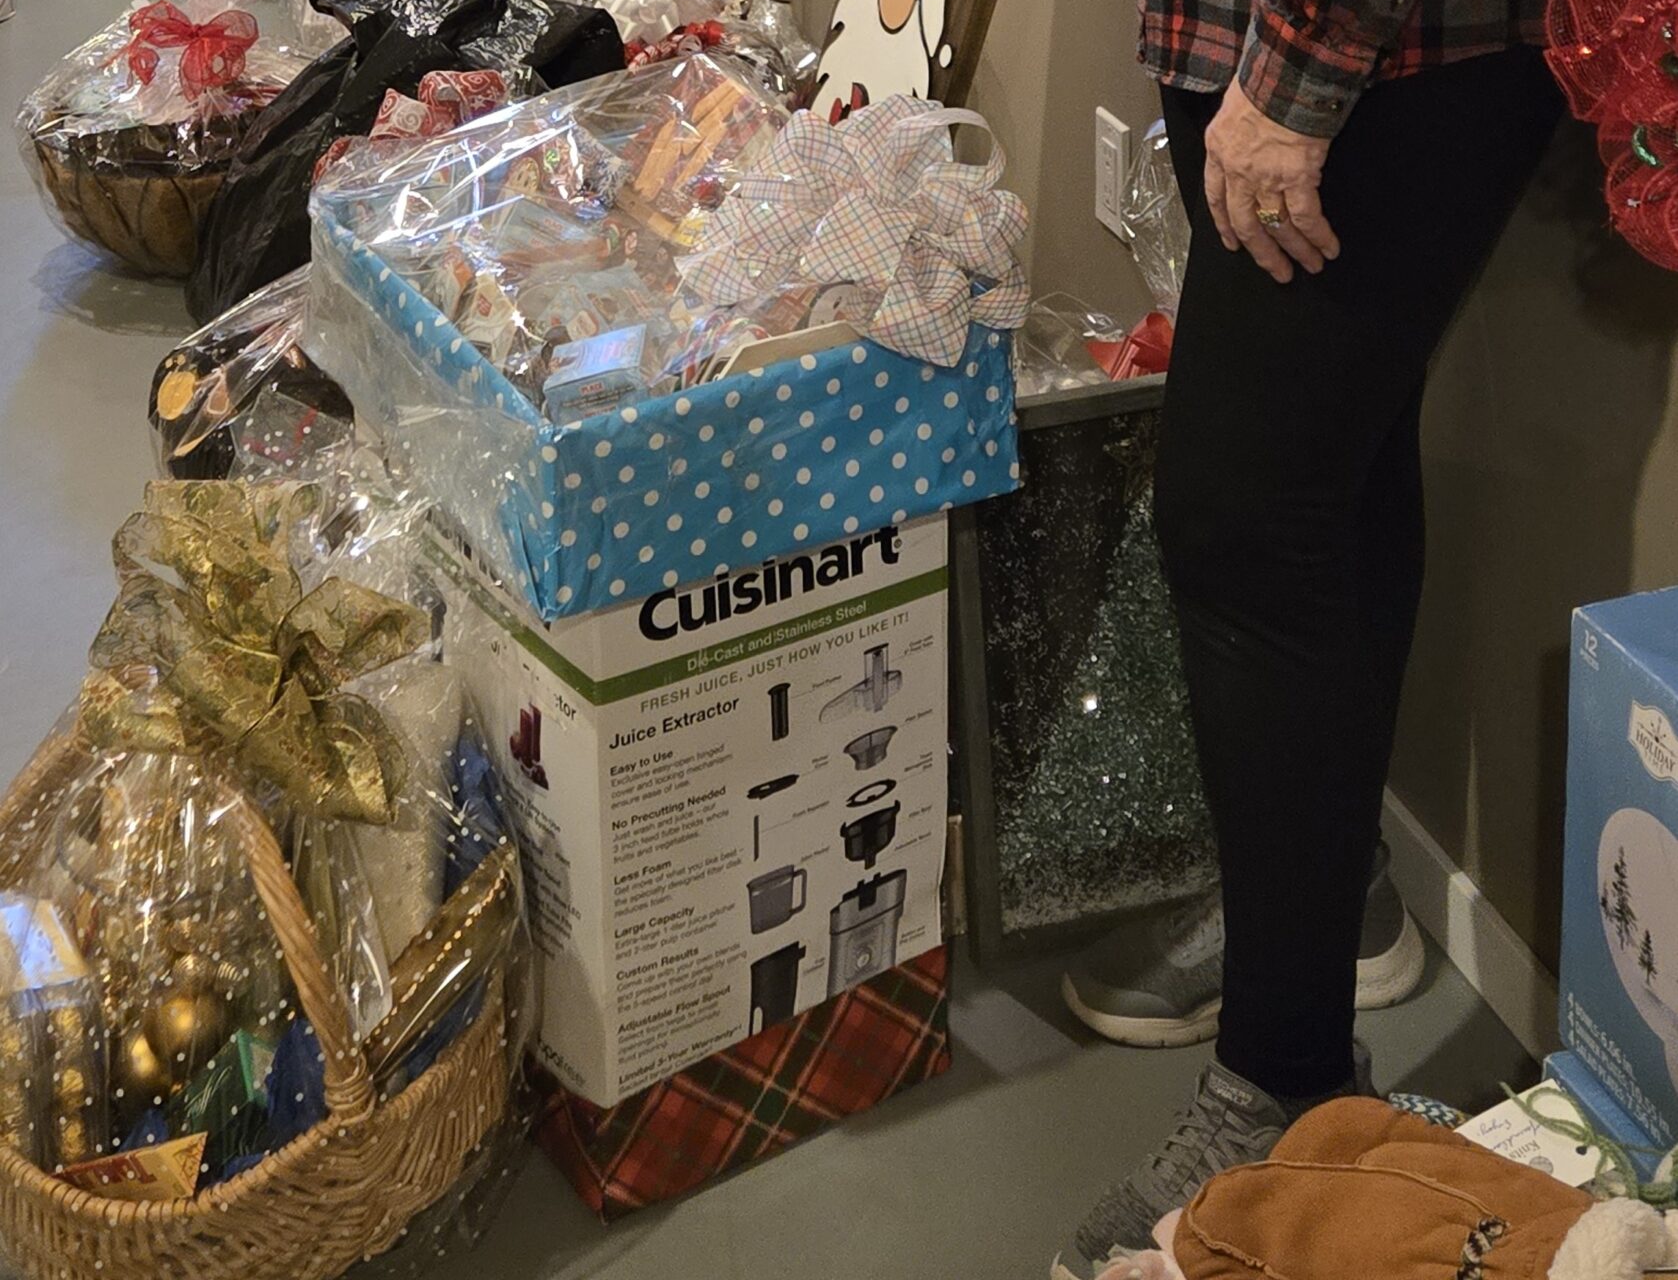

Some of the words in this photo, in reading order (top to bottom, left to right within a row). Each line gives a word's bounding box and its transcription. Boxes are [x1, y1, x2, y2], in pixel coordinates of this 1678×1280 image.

[639, 526, 899, 641] Cuisinart
[748, 632, 774, 652] and
[774, 612, 832, 643] Stainless
[836, 600, 867, 622] Steel
[1585, 629, 1598, 658] 12
[640, 686, 690, 713] FRESH
[695, 672, 744, 696] JUICE,
[747, 656, 783, 678] JUST
[788, 640, 822, 662] HOW
[826, 631, 854, 650] YOU
[859, 618, 890, 640] LIKE
[892, 611, 909, 626] IT!
[609, 726, 656, 749] Juice
[662, 698, 739, 733] Extractor
[610, 762, 637, 776] Easy
[640, 758, 649, 767] to
[653, 751, 673, 763] Use
[1635, 729, 1676, 772] HOLIDAY
[612, 820, 628, 831] No
[631, 801, 685, 825] Precutting
[687, 786, 726, 807] Needed
[614, 870, 639, 885] Less
[642, 860, 672, 876] Foam
[614, 923, 646, 939] Large
[648, 906, 695, 928] Capacity
[616, 962, 658, 981] Custom
[660, 948, 699, 967] Results
[618, 1007, 673, 1034] Adjustable
[675, 1000, 700, 1014] Flow
[702, 985, 731, 1002] Spout
[619, 1061, 655, 1085] Limited
[1509, 1139, 1541, 1159] Knits
